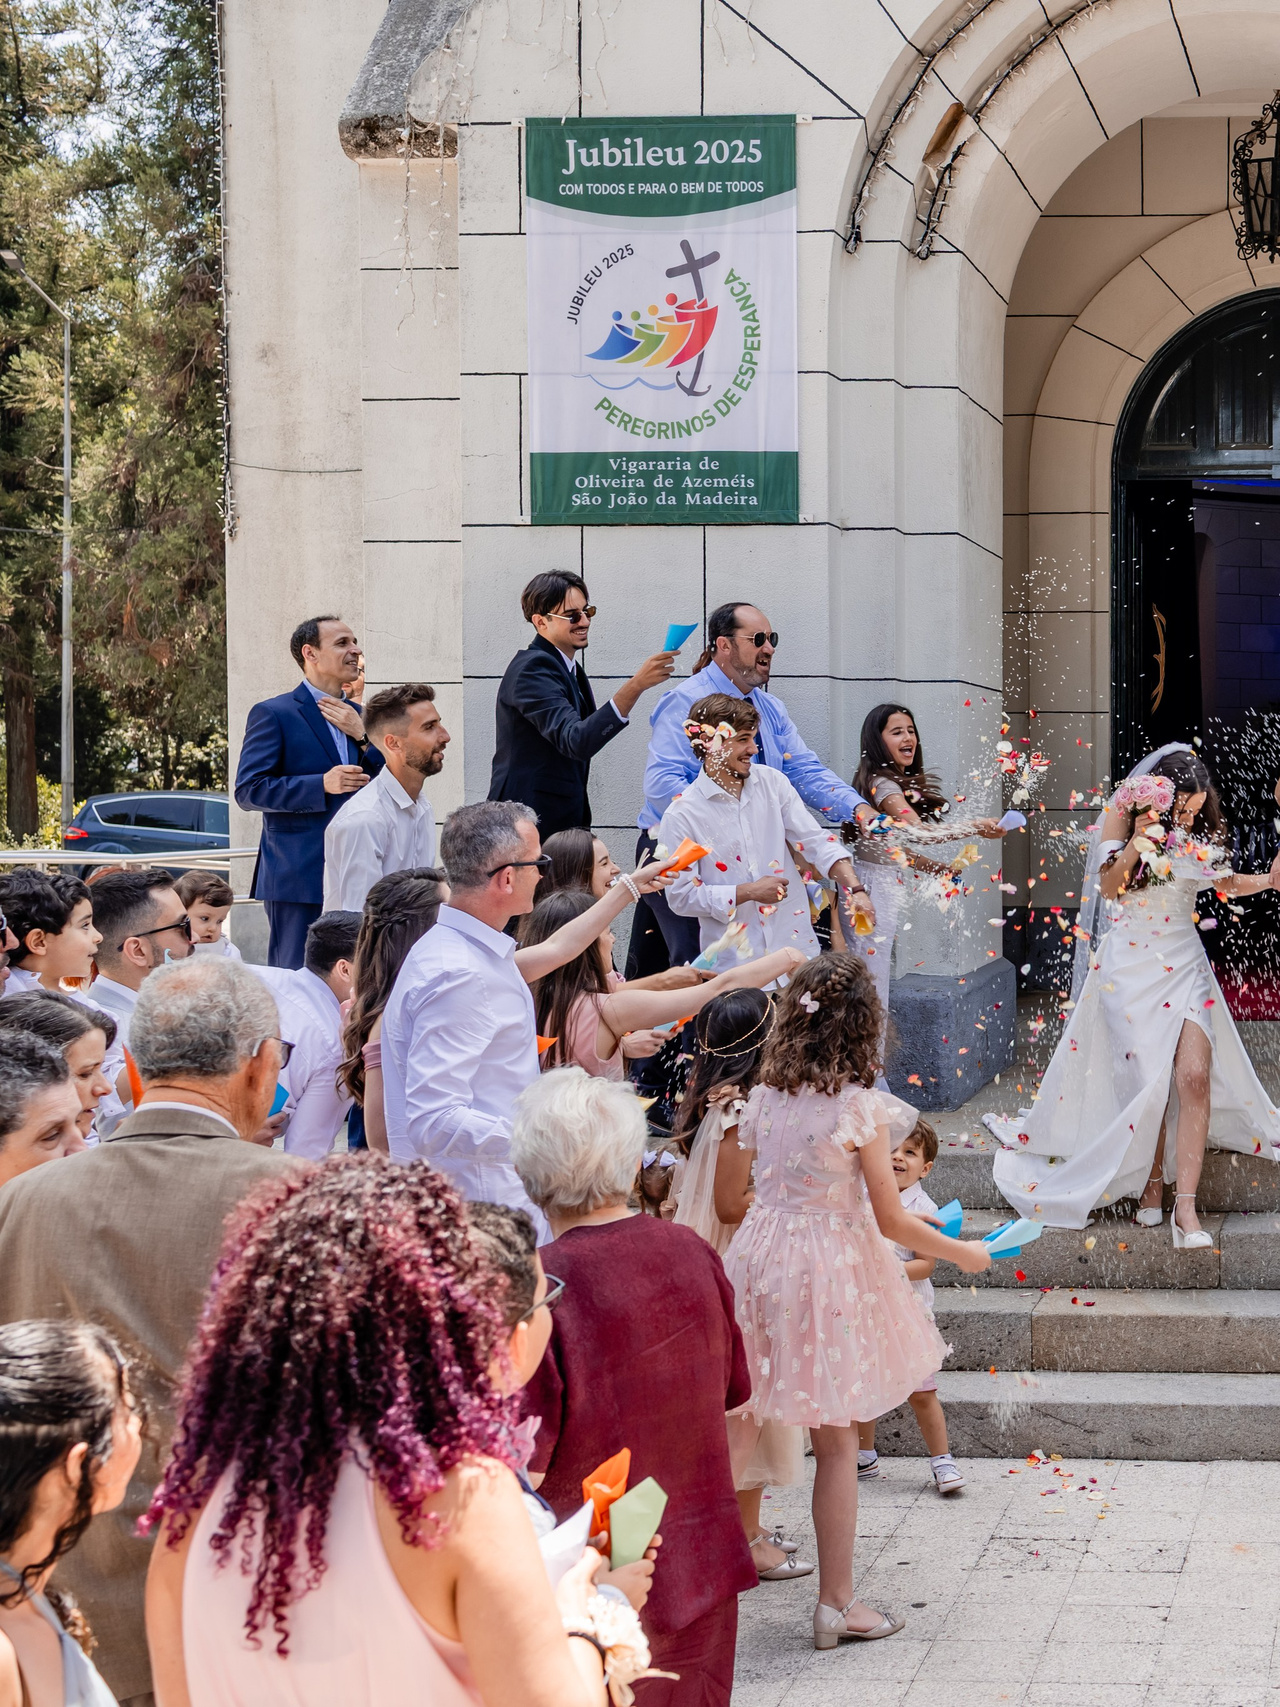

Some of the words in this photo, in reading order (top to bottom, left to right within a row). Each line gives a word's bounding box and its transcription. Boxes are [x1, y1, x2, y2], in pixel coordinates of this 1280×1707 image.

[562, 137, 686, 175] Jubileu
[693, 139, 763, 165] 2025
[559, 183, 583, 195] COM
[586, 183, 626, 195] TODOS
[628, 183, 635, 195] E
[638, 182, 667, 194] PARA
[670, 182, 678, 194] O
[681, 181, 705, 194] BEM
[708, 181, 723, 193] DE
[725, 181, 764, 193] TODOS
[567, 266, 603, 325] JUBILEU
[602, 243, 635, 270] 2025
[724, 268, 762, 392] ESPERANÇA
[594, 396, 716, 440] PEREGRINOS
[713, 388, 743, 418] DE
[609, 457, 692, 474] Vigararia
[698, 456, 720, 470] de
[575, 475, 645, 489] Oliveira
[653, 474, 674, 488] de
[681, 474, 755, 488] Azeméis
[571, 491, 602, 506] São
[608, 491, 648, 509] João
[655, 490, 677, 505] da
[685, 490, 759, 506] Madeira
